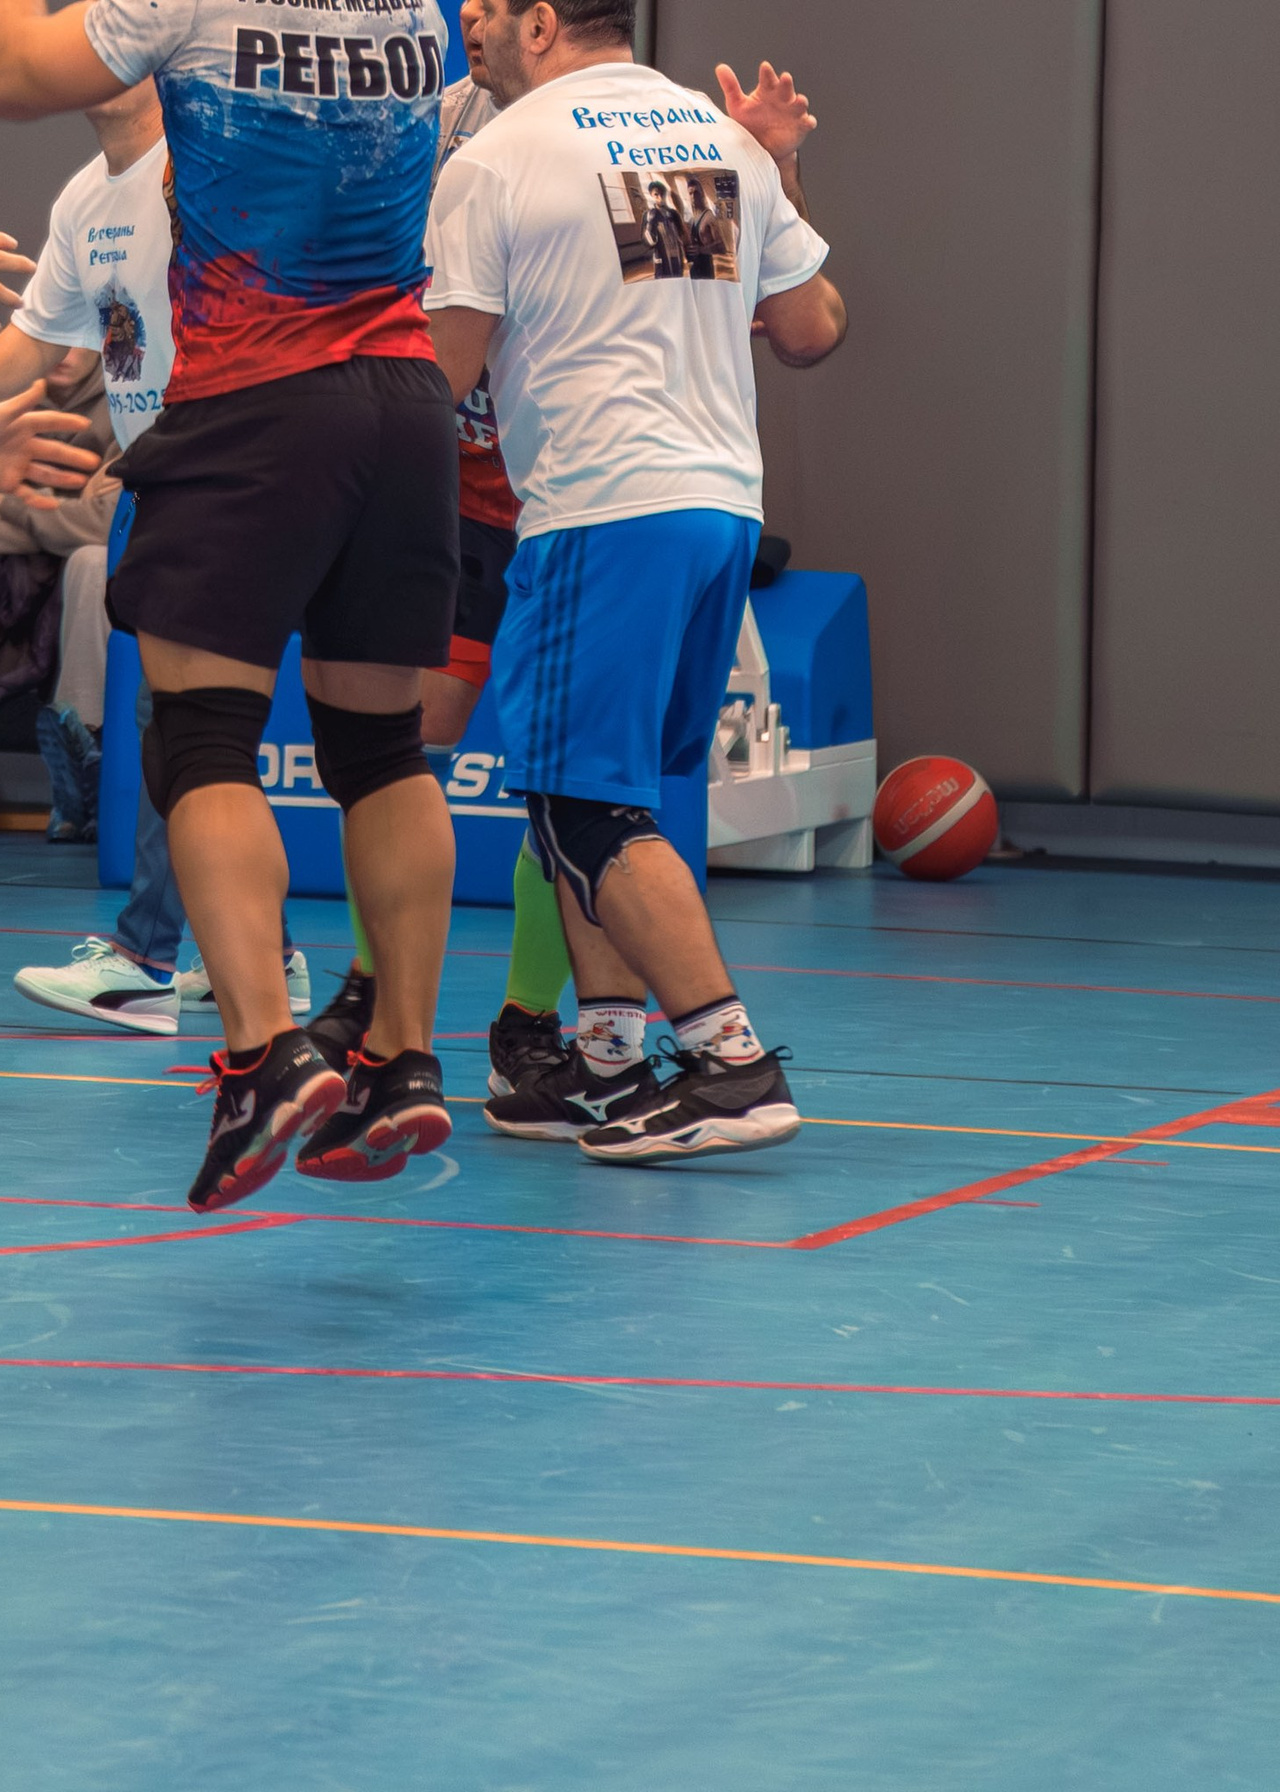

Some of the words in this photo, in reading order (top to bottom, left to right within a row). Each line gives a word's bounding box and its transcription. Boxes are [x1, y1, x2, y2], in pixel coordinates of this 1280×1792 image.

[234, 26, 444, 99] РЕГБОЛ
[572, 106, 717, 133] Ветераны
[607, 140, 723, 167] Регбола
